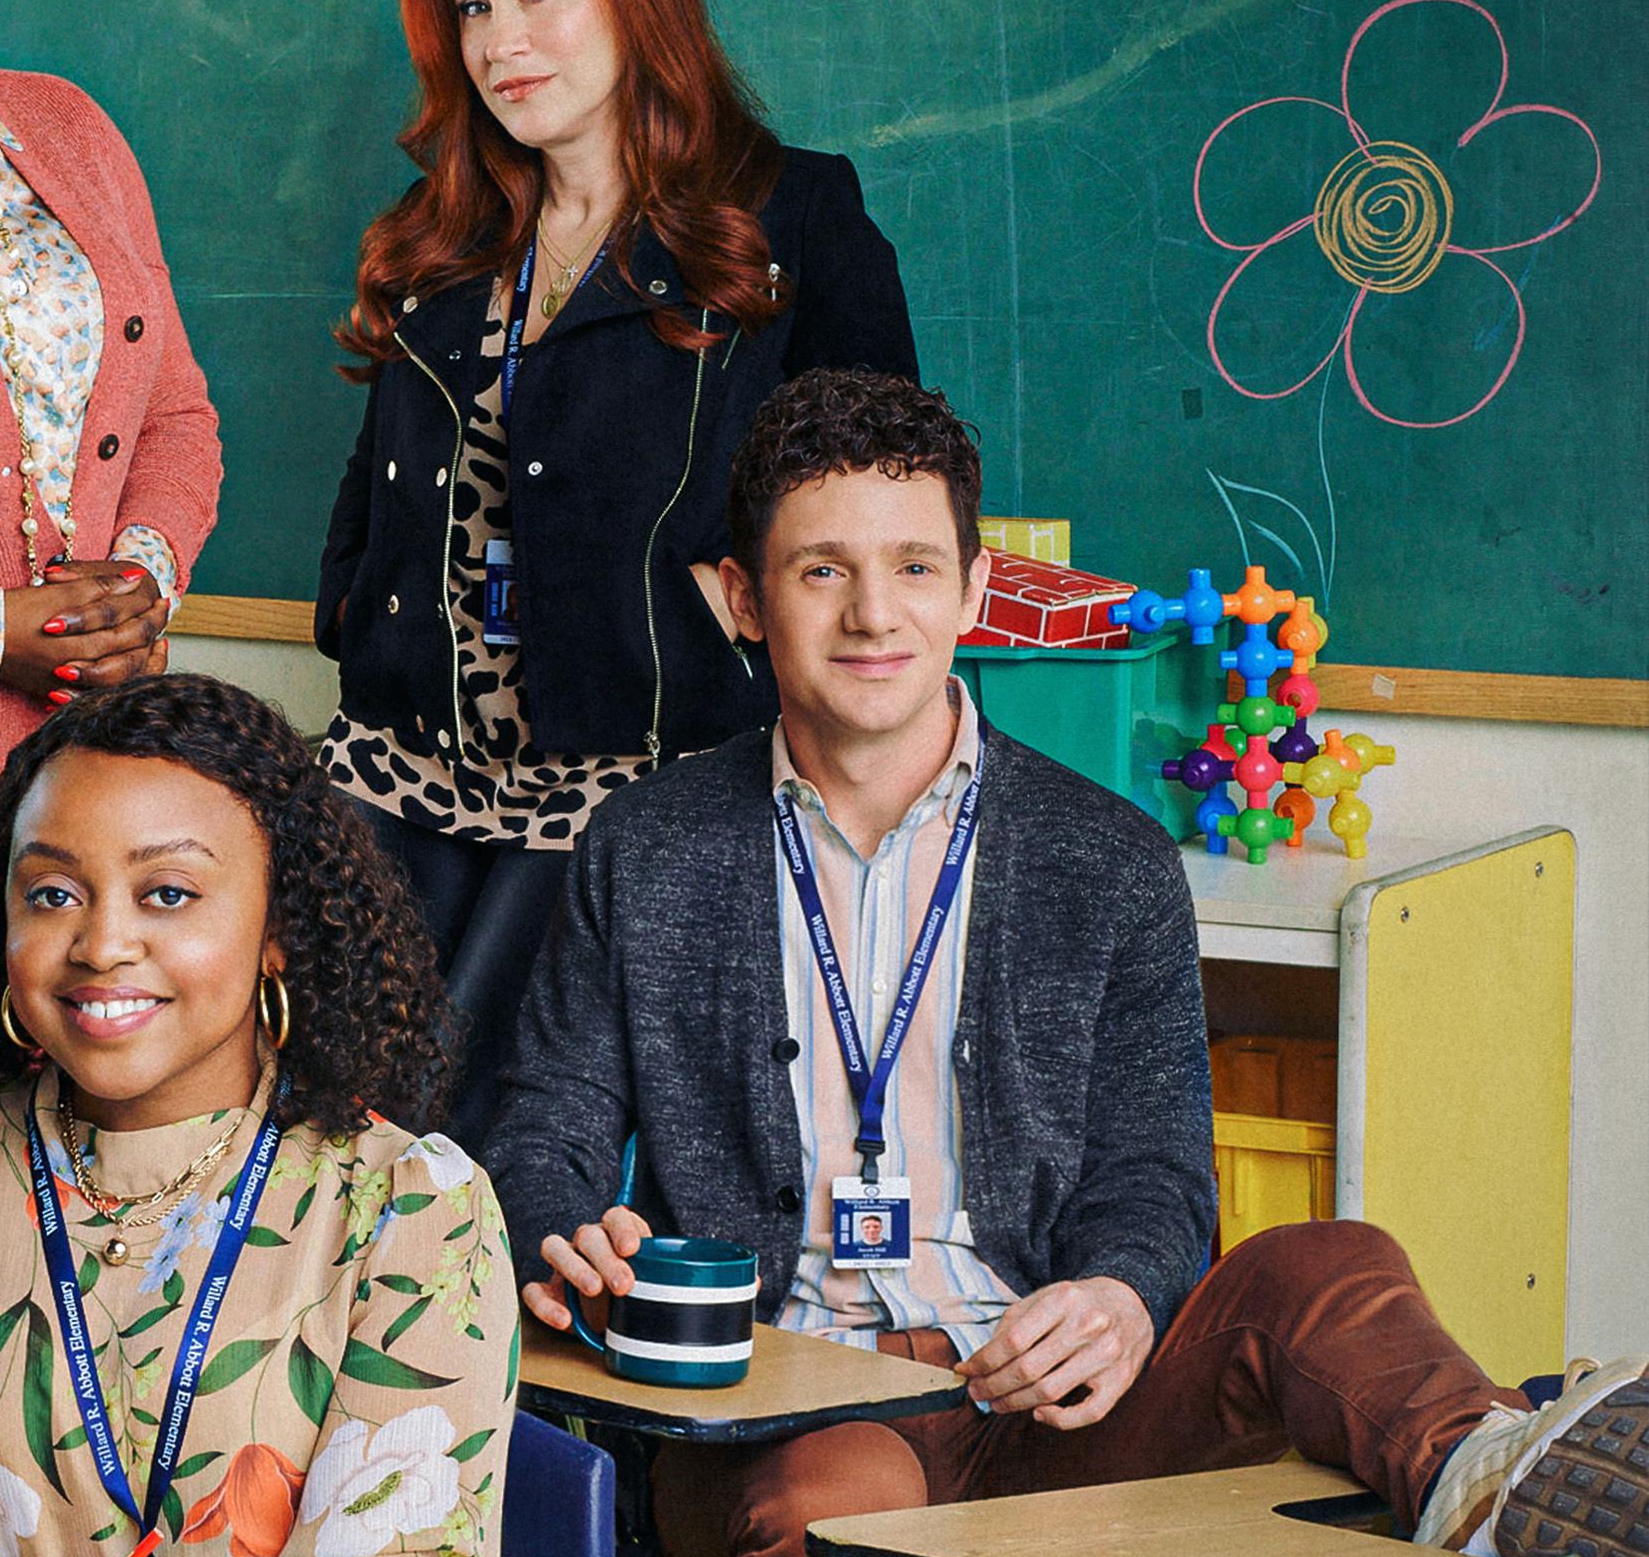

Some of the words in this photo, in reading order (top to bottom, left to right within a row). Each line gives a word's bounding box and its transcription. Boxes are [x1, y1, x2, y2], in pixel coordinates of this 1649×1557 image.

[781, 815, 805, 874] Elementary
[945, 827, 968, 865] Willard
[959, 816, 972, 829] R.
[811, 914, 831, 955] Willard
[913, 904, 945, 966] Elementary
[822, 955, 835, 970] R.
[902, 966, 922, 1005] Abbott
[826, 971, 846, 1009] Abbott
[896, 1006, 910, 1019] R.
[838, 1009, 862, 1073] Elementary
[881, 1018, 904, 1060] Willard
[255, 1121, 280, 1164] Abbott
[36, 1171, 49, 1189] R.
[229, 1162, 267, 1231] Elementary
[38, 1188, 59, 1236] Willard
[60, 1280, 86, 1352] Elementary
[200, 1275, 227, 1321] Willard
[193, 1320, 211, 1336] R.
[78, 1353, 97, 1400] Abbott
[180, 1338, 204, 1388] Abbott
[86, 1402, 101, 1422] R.
[157, 1389, 191, 1471] Elementary
[91, 1422, 116, 1476] Willard
